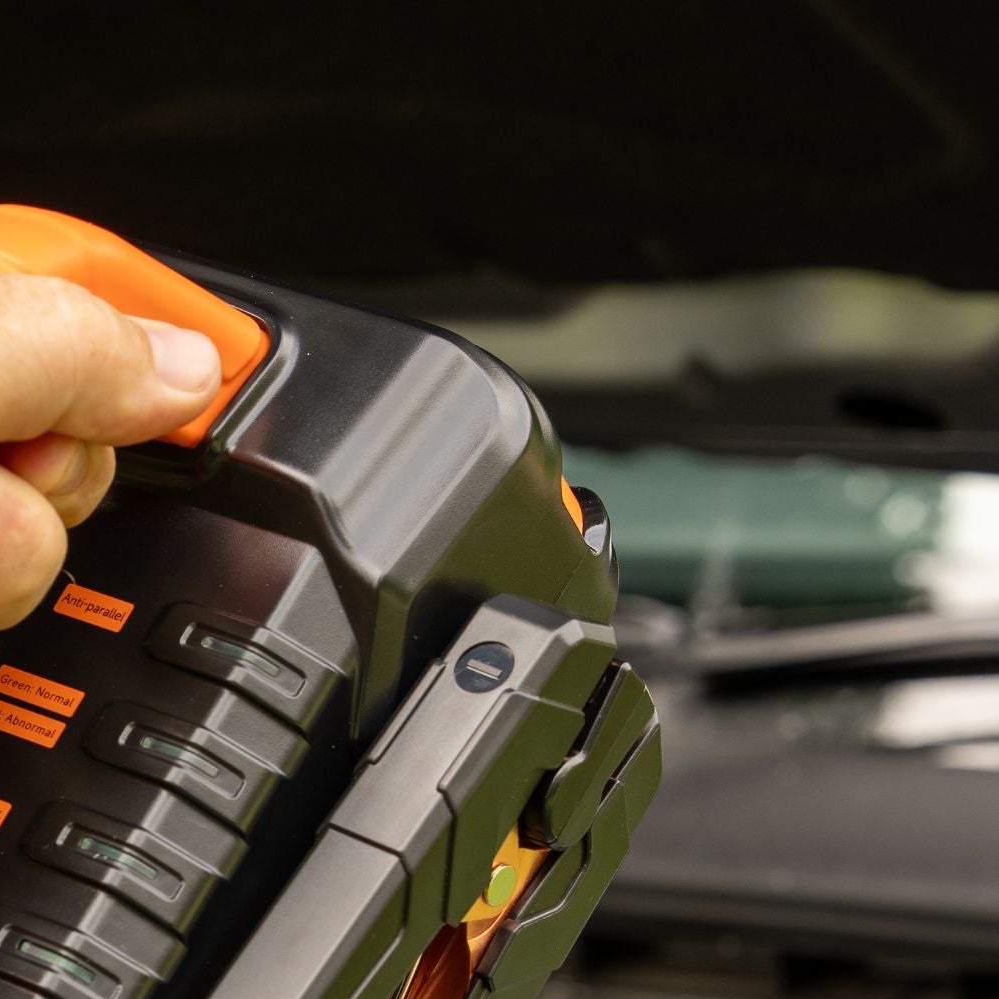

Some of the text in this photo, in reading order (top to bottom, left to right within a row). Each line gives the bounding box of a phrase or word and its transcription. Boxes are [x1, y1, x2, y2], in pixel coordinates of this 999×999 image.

[61, 593, 126, 622] Anti-parallel
[0, 674, 75, 708] Green: Normal
[5, 714, 57, 739] Abnormal
